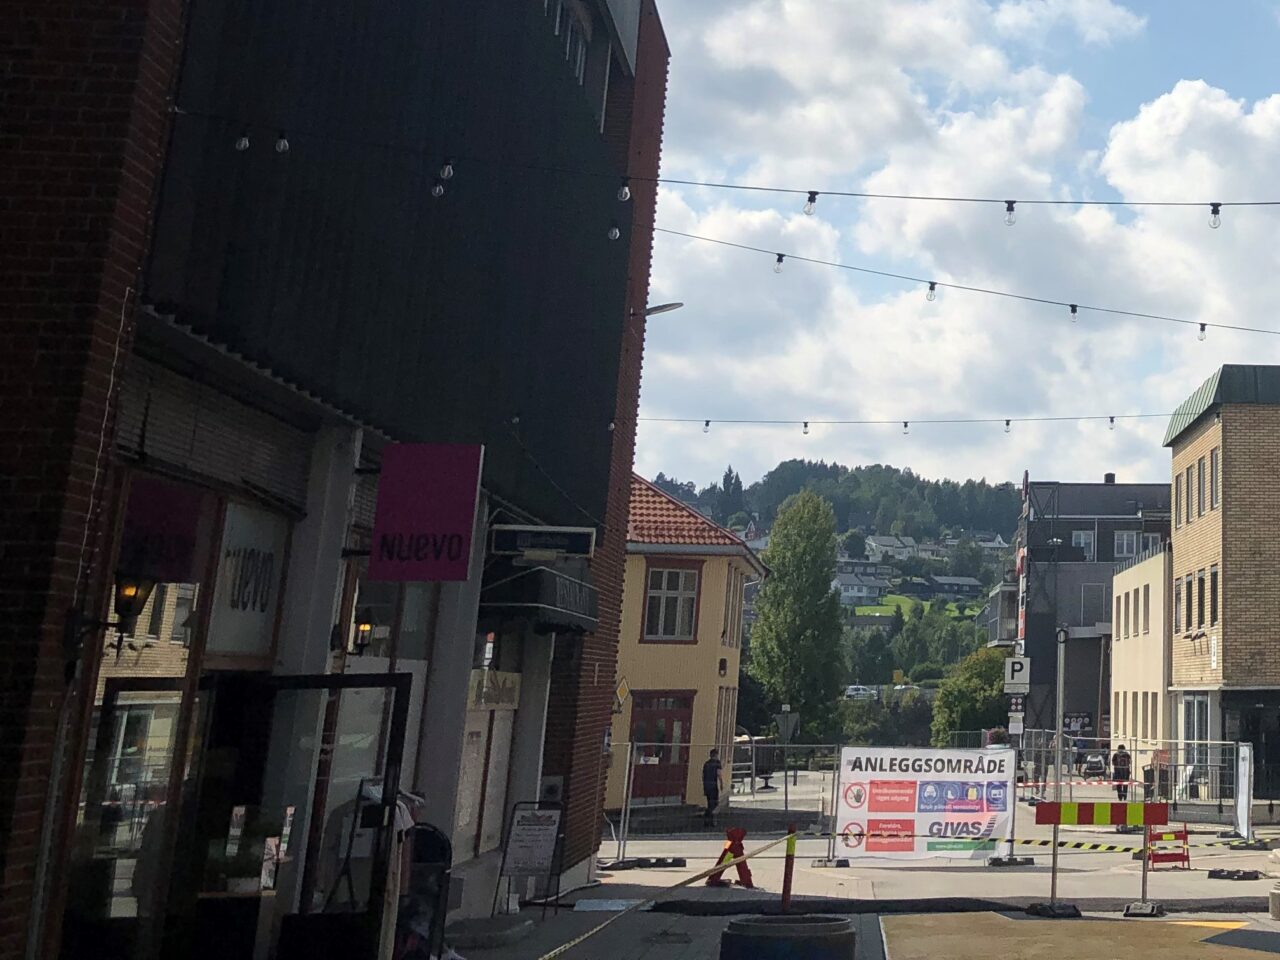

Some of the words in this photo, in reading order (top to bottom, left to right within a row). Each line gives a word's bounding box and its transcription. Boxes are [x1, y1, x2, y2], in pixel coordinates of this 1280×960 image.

[1011, 661, 1024, 681] P
[851, 756, 1006, 774] ANLEGGSOMRÅDE
[928, 821, 982, 837] GIVAS
